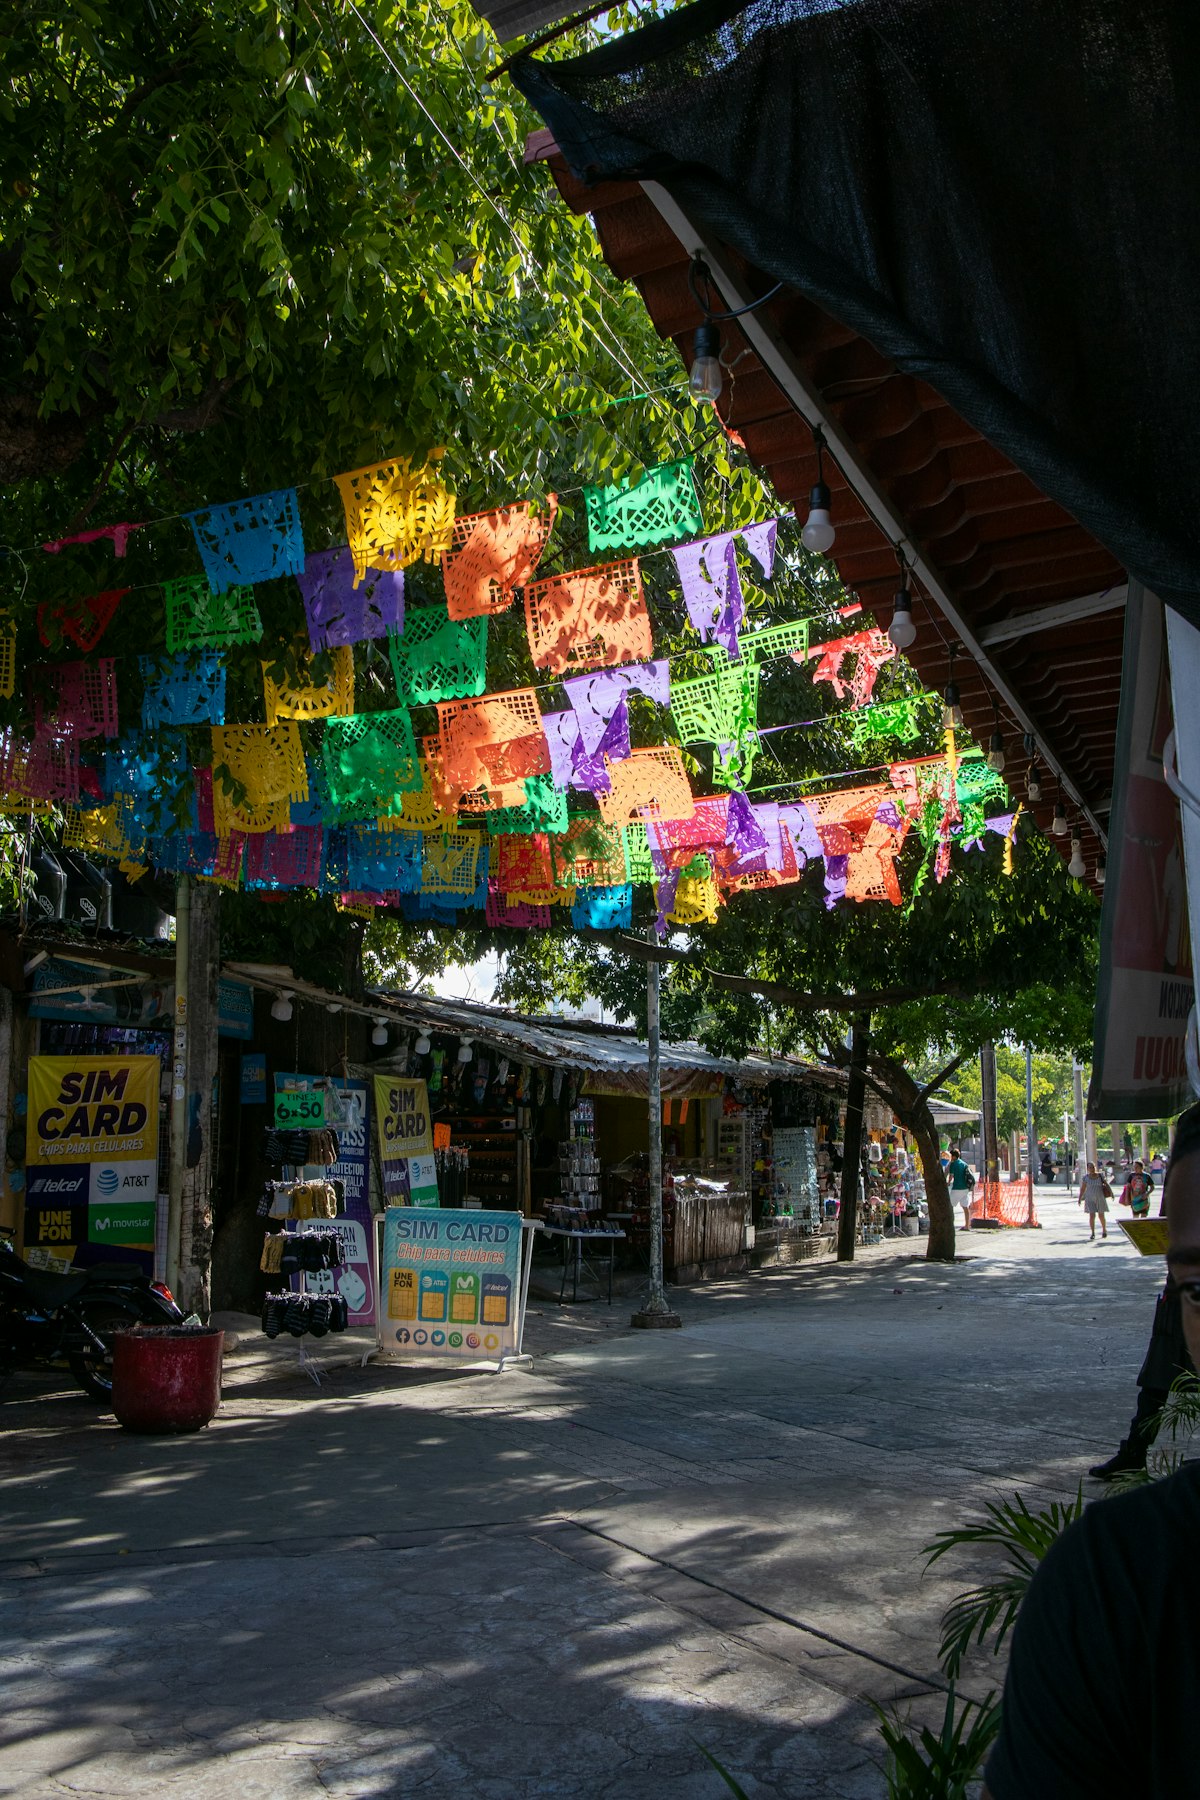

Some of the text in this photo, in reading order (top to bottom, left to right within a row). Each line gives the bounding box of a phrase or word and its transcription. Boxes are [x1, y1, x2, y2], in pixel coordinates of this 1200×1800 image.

[57, 1068, 130, 1105] SIM
[389, 1087, 416, 1114] SIM
[37, 1102, 147, 1141] CARD
[383, 1112, 427, 1141] CARD
[38, 1139, 145, 1156] CHIPS PARA CELULARES
[43, 1177, 84, 1193] telcel
[122, 1175, 150, 1187] AT&T
[39, 1210, 72, 1225] UNE
[112, 1218, 151, 1228] movistar
[39, 1225, 72, 1241] FON
[396, 1219, 510, 1244] SIM CARD
[398, 1242, 505, 1264] Chip para celulares
[394, 1271, 413, 1280] UNE
[393, 1280, 413, 1289] FON
[490, 1284, 509, 1292] telcel
